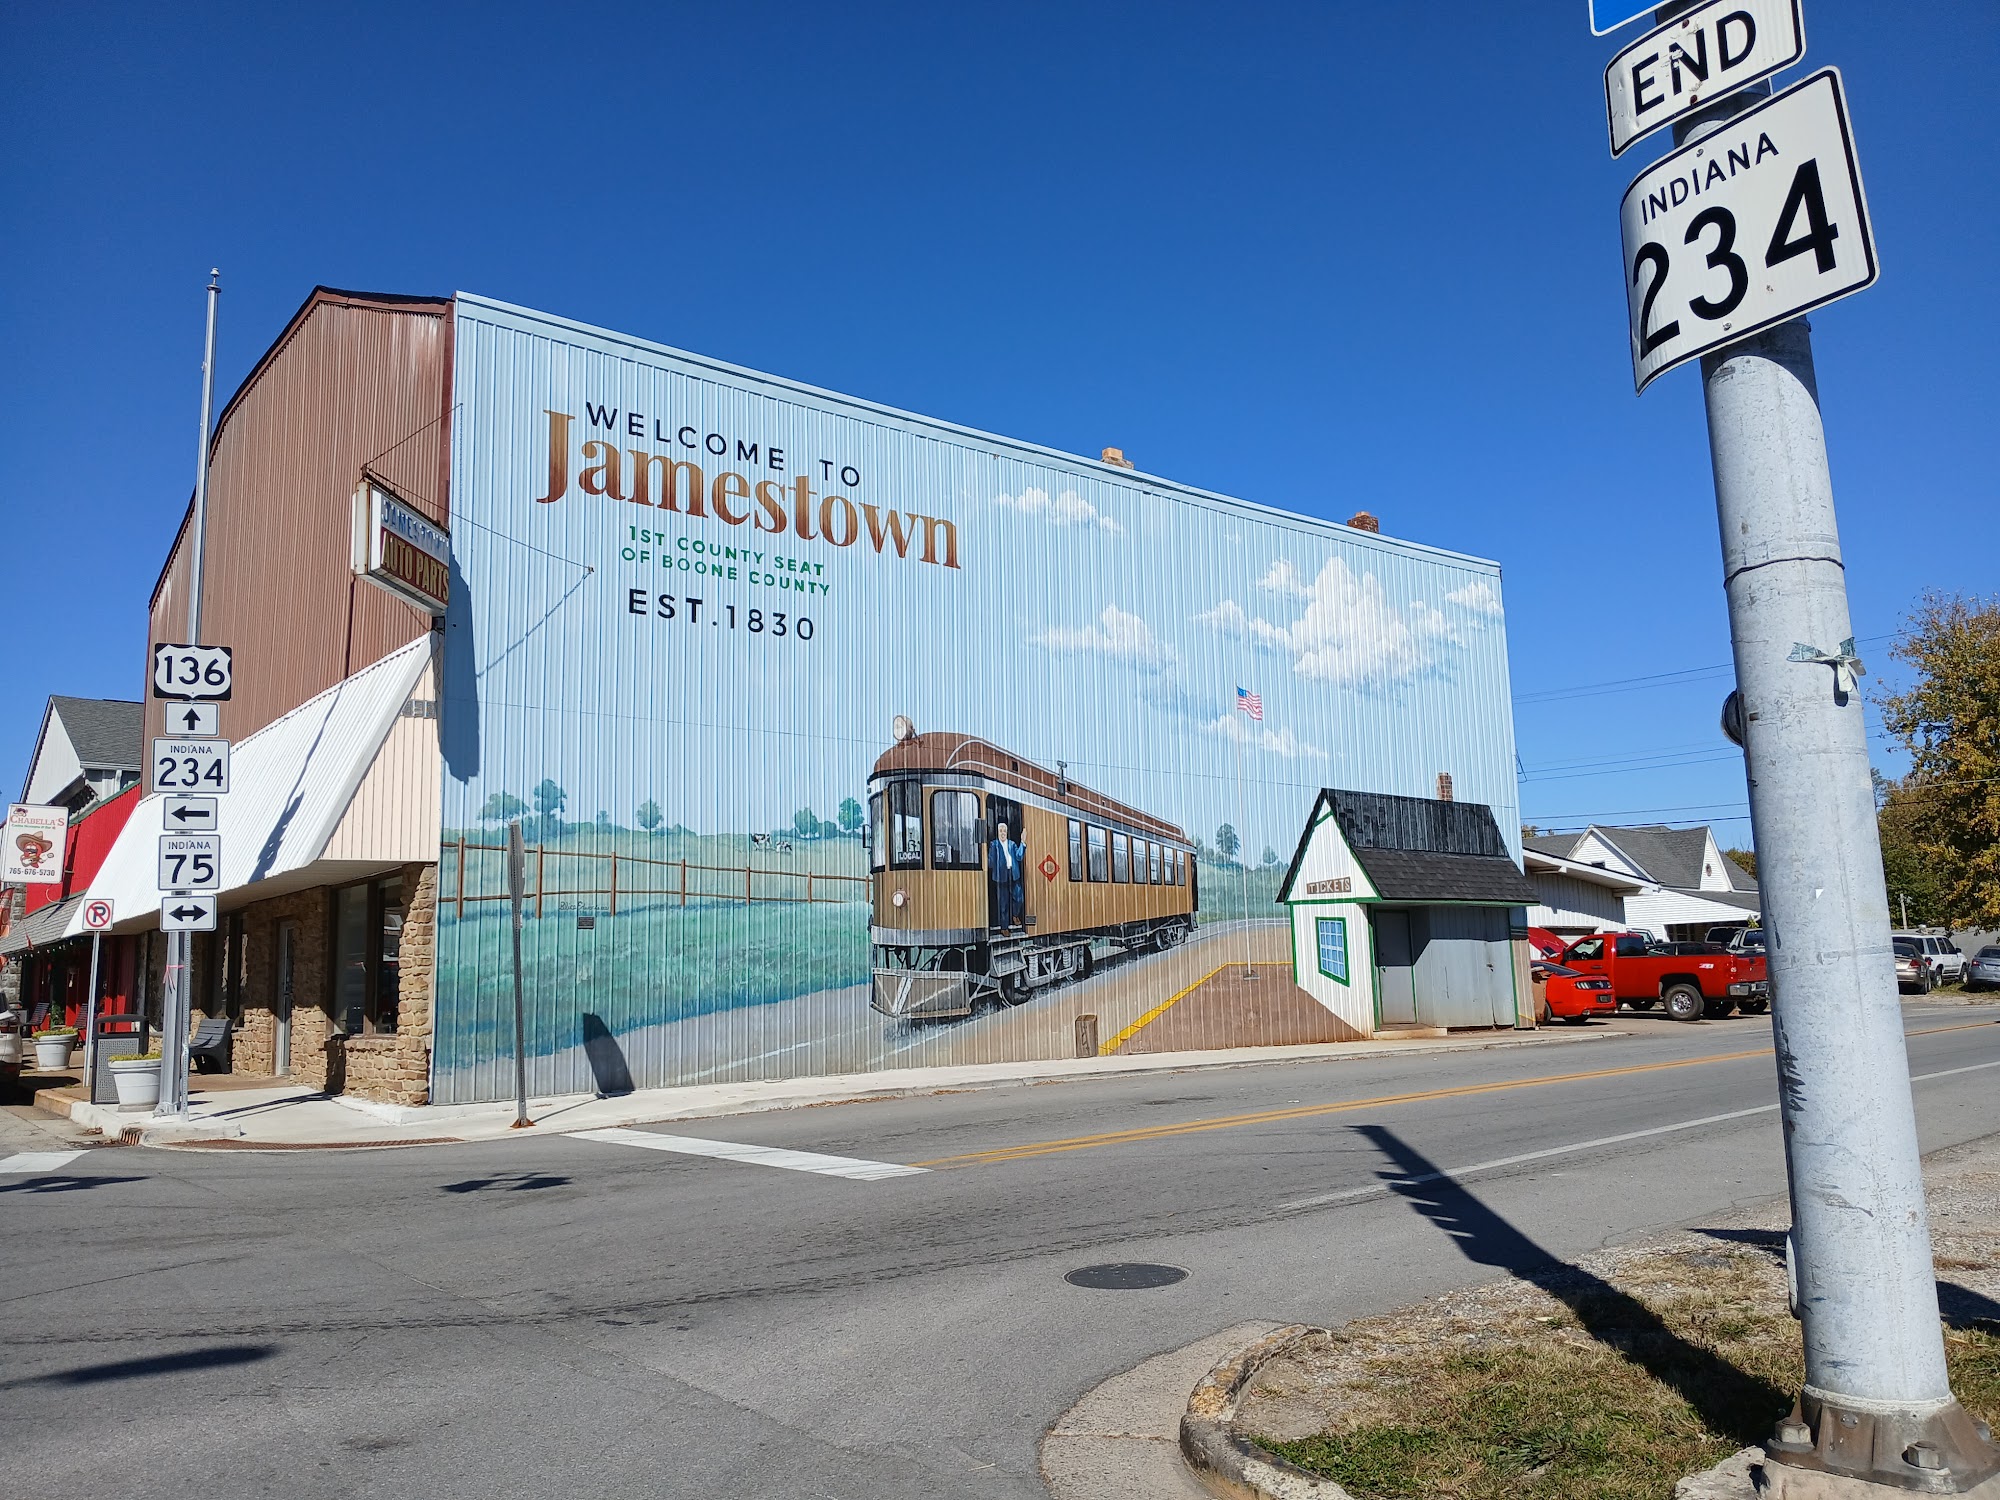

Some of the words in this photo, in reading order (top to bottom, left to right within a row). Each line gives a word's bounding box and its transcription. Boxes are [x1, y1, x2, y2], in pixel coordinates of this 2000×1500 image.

[1631, 10, 1757, 117] END
[1641, 132, 1779, 226] INDIANA
[1633, 157, 1839, 362] 234
[586, 401, 784, 471] WELCOME
[819, 459, 860, 487] TO
[536, 409, 961, 570] Jamestown
[381, 531, 413, 581] AUTO
[416, 552, 450, 601] PARTS
[621, 547, 650, 563] OF
[662, 555, 737, 581] BOONE
[750, 571, 830, 597] COUNTY
[629, 526, 665, 546] 1ST
[677, 537, 764, 565] COUNTY
[774, 556, 824, 576] SEAT
[164, 655, 226, 686] 136
[158, 757, 223, 787] 234
[170, 745, 213, 754] INDIANA
[10, 815, 65, 827] CHABELLA'S
[168, 841, 211, 850] INDIANA
[165, 854, 214, 884] 75
[1309, 879, 1351, 893] TICKETS
